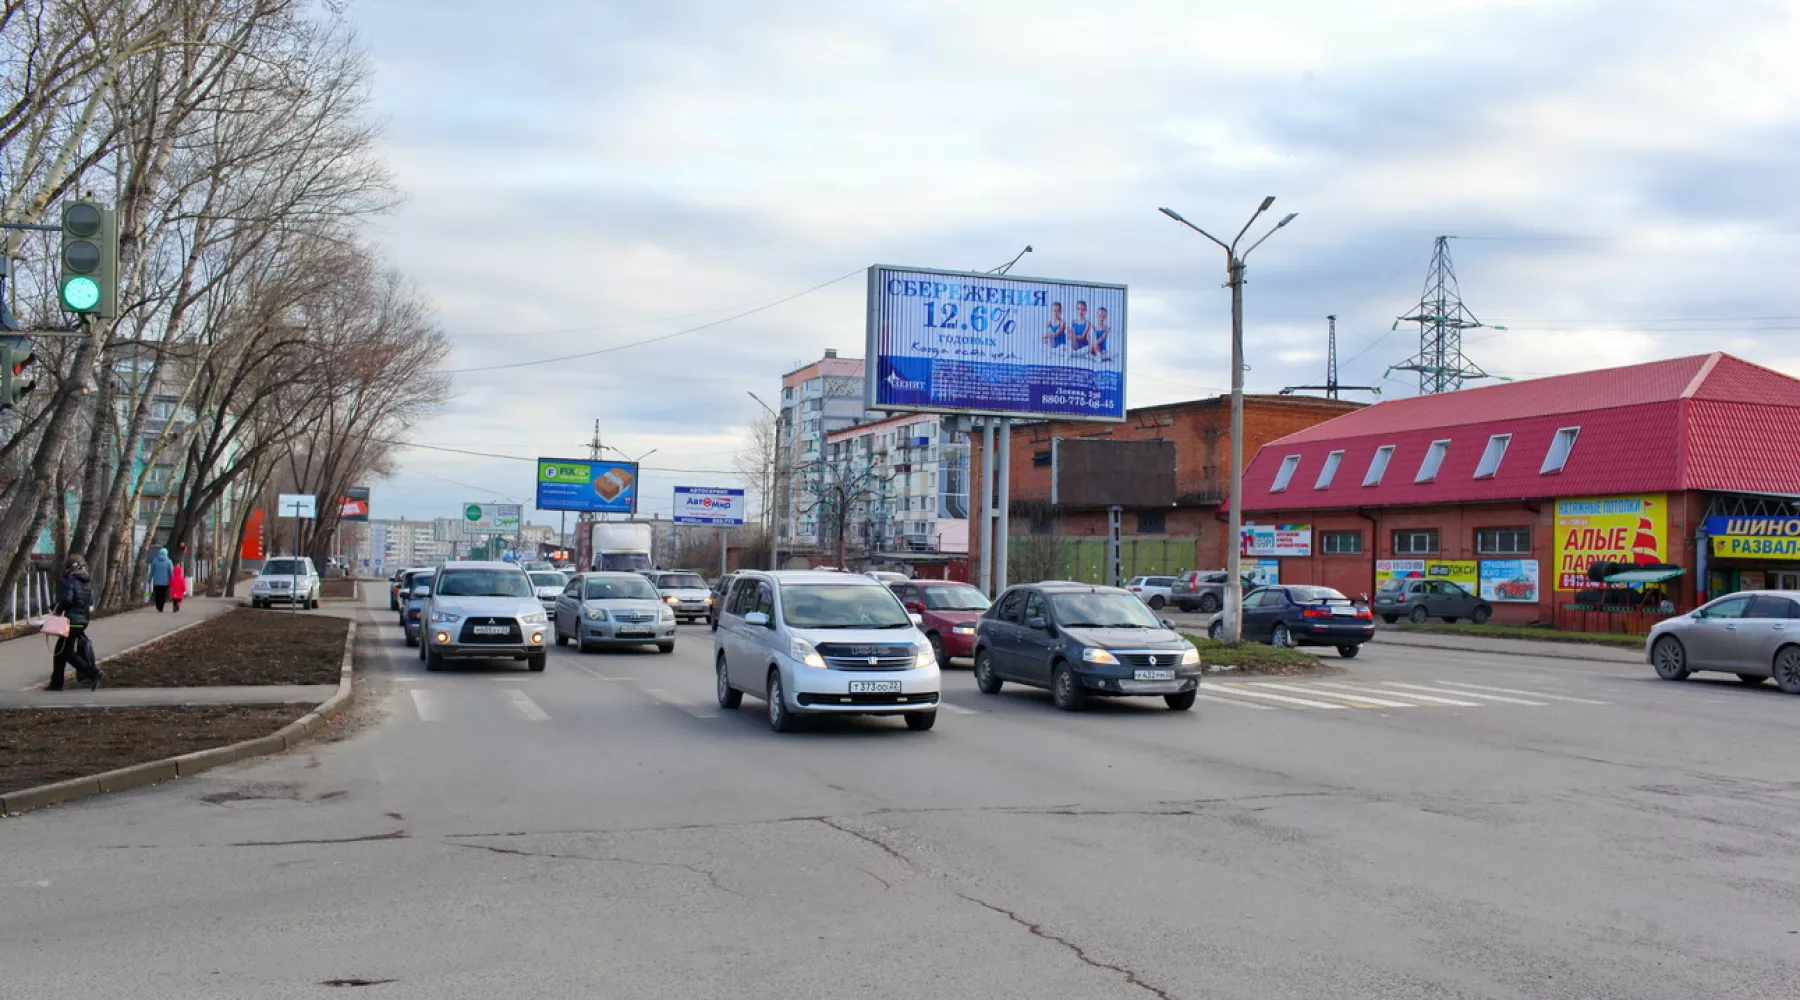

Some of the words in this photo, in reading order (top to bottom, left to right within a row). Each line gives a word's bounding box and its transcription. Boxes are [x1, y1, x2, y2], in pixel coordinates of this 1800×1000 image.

[887, 278, 1048, 307] СБЕРЕЖЕНИЯ
[922, 301, 1017, 335] 12.6%
[1558, 501, 1601, 515] НАТЯЖНЫЕ
[1603, 499, 1641, 514] ПОТОЛКИ
[1564, 527, 1628, 551] АЛЫЕ
